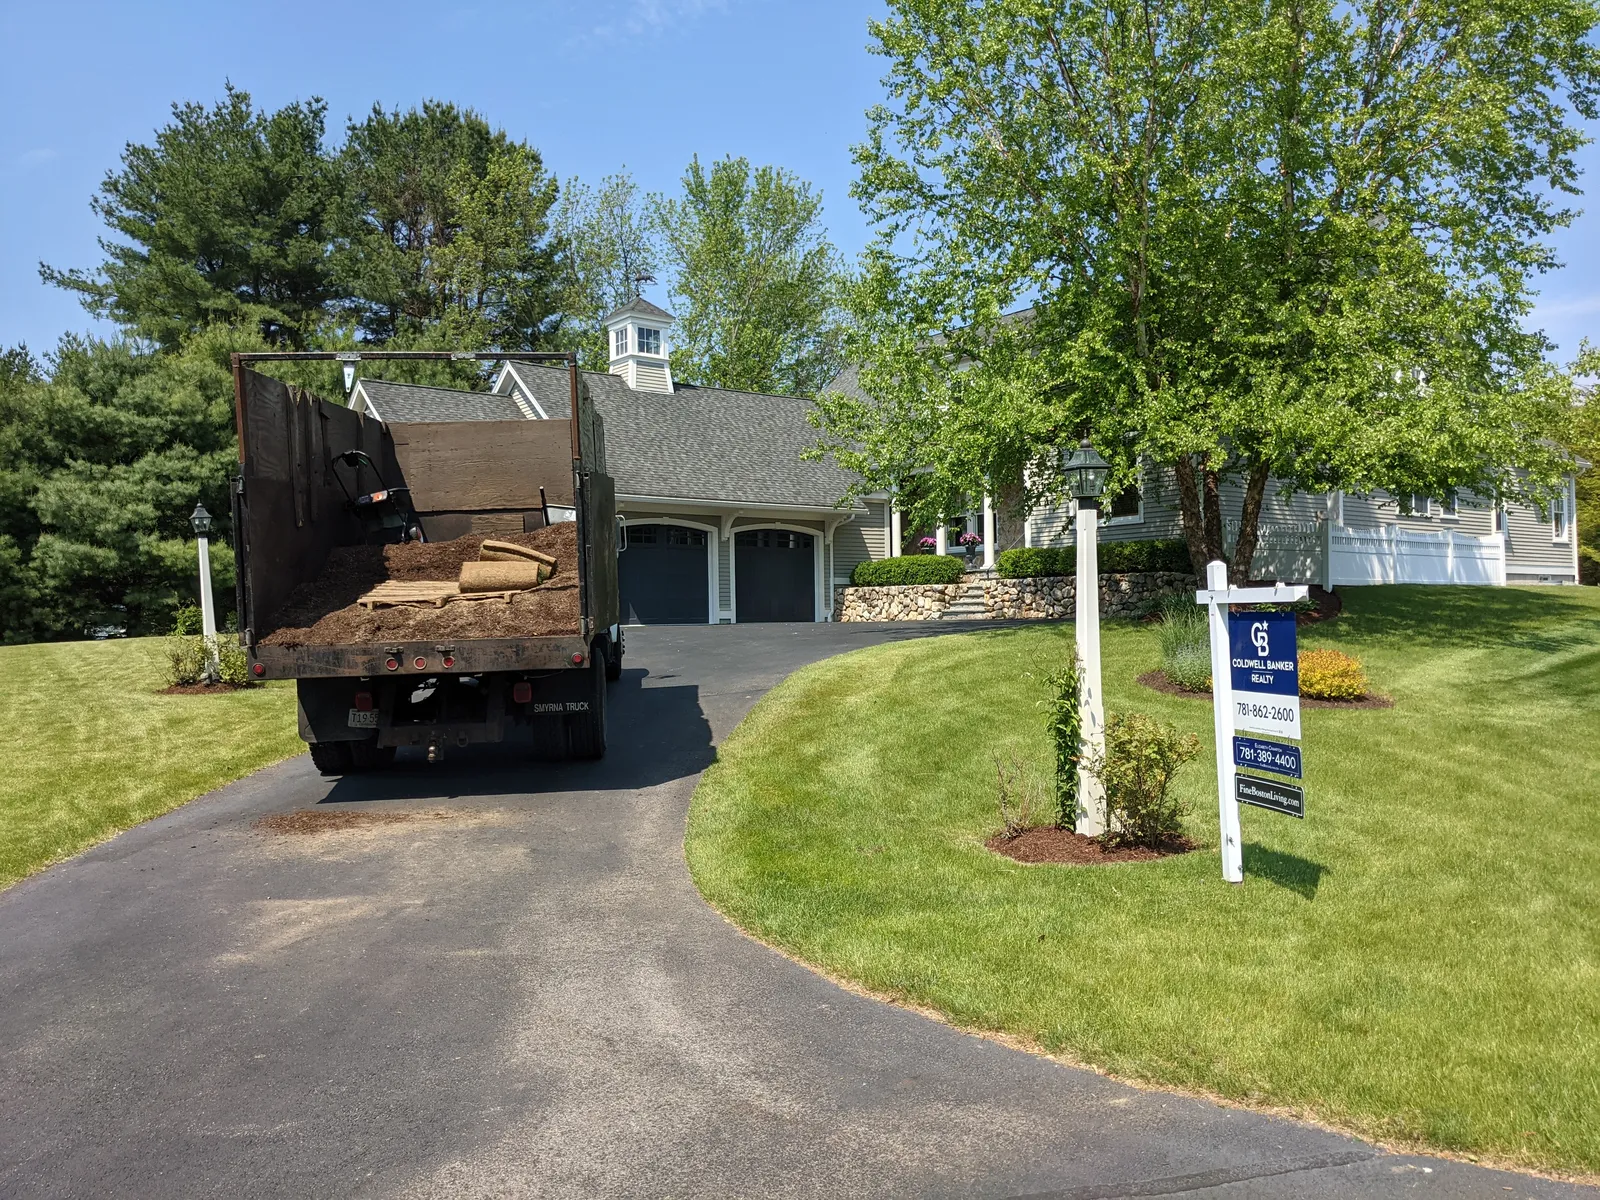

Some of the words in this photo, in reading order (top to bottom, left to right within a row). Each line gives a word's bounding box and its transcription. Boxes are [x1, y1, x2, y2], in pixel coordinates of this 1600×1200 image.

[1232, 658, 1266, 669] COLDWELL
[1267, 660, 1294, 671] BANKER
[1251, 674, 1274, 684] REALTY
[534, 703, 563, 713] SMYRNA
[565, 701, 589, 711] TRUCK
[1237, 702, 1294, 722] 781-862-2600
[1239, 747, 1297, 769] 781-389-4400
[1239, 784, 1300, 807] FineBostonLiving.com
